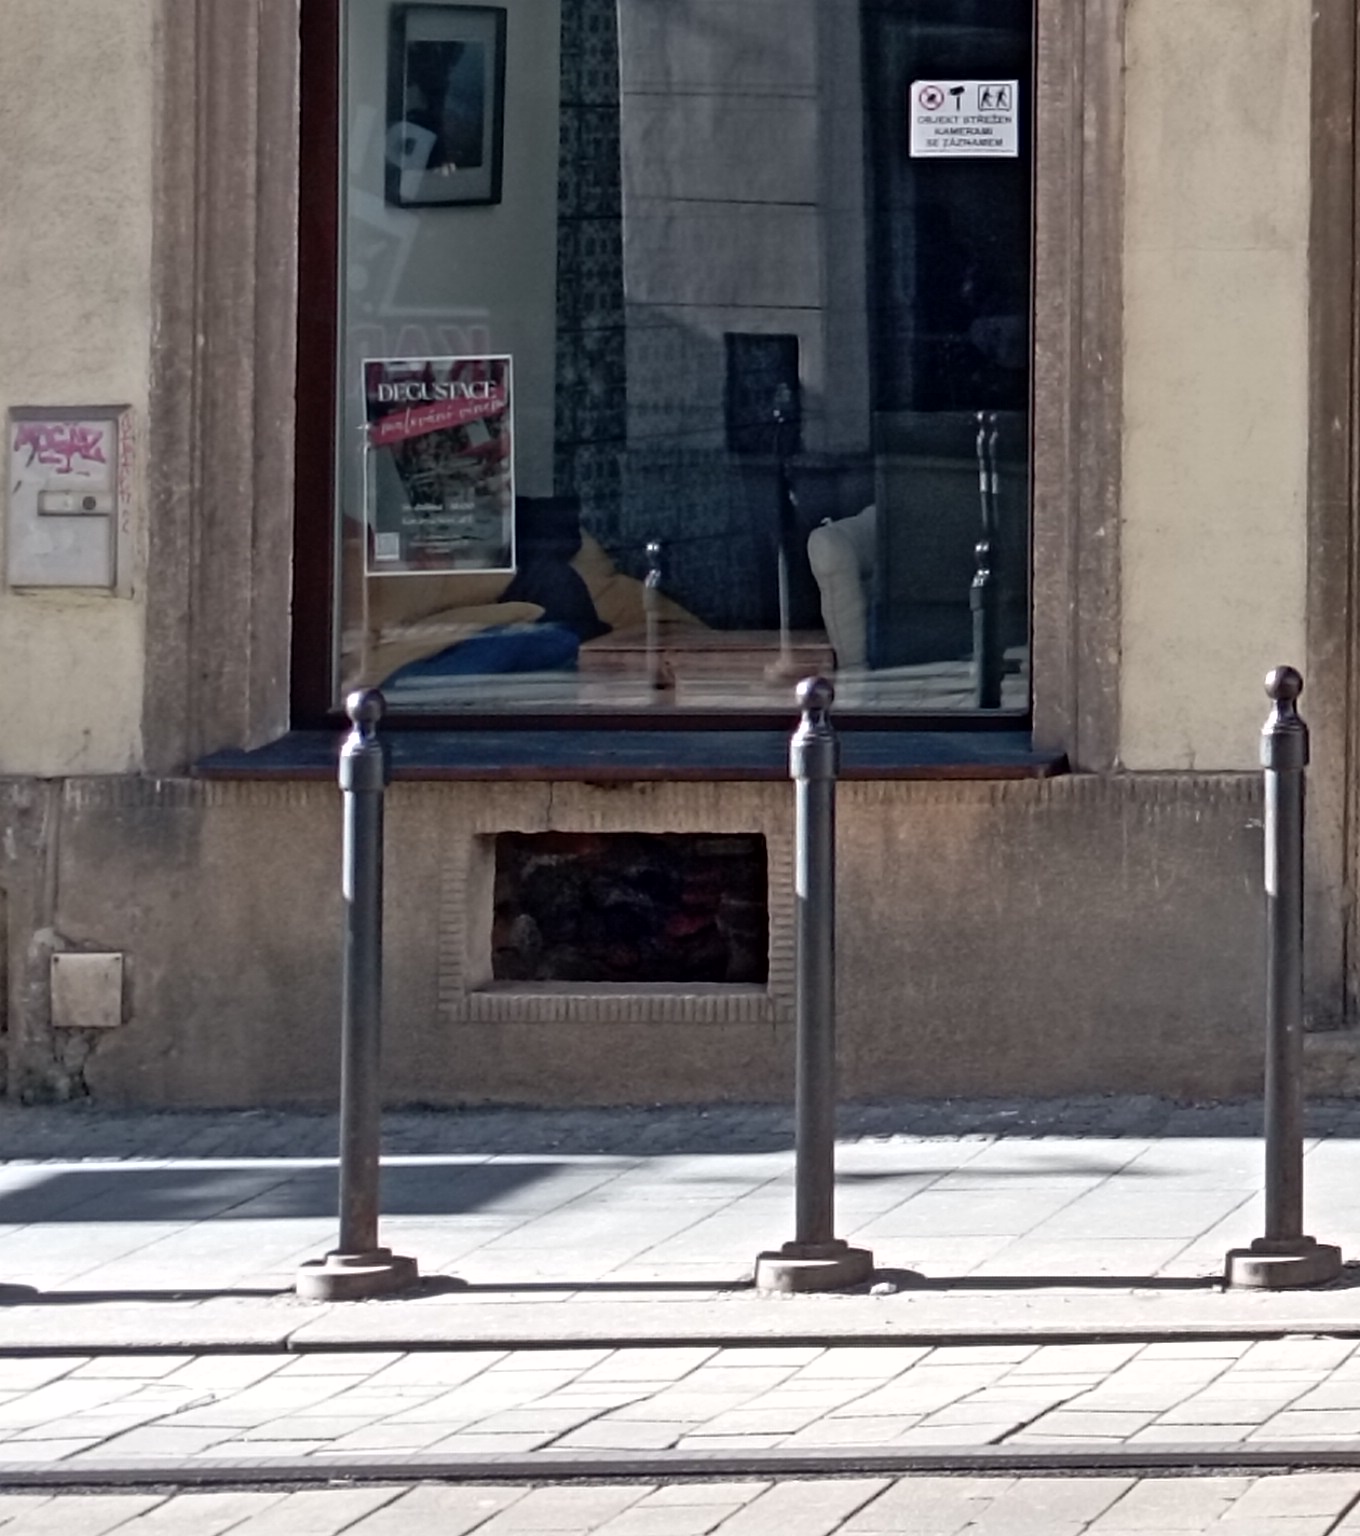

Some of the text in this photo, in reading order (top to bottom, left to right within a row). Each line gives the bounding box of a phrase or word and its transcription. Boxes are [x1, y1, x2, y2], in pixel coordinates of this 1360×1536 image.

[917, 116, 958, 124] OBJEKT
[935, 127, 993, 135] KAMERAMI
[943, 137, 1003, 147] ZÁZNAMEM
[378, 381, 497, 402] DEGUSTACE
